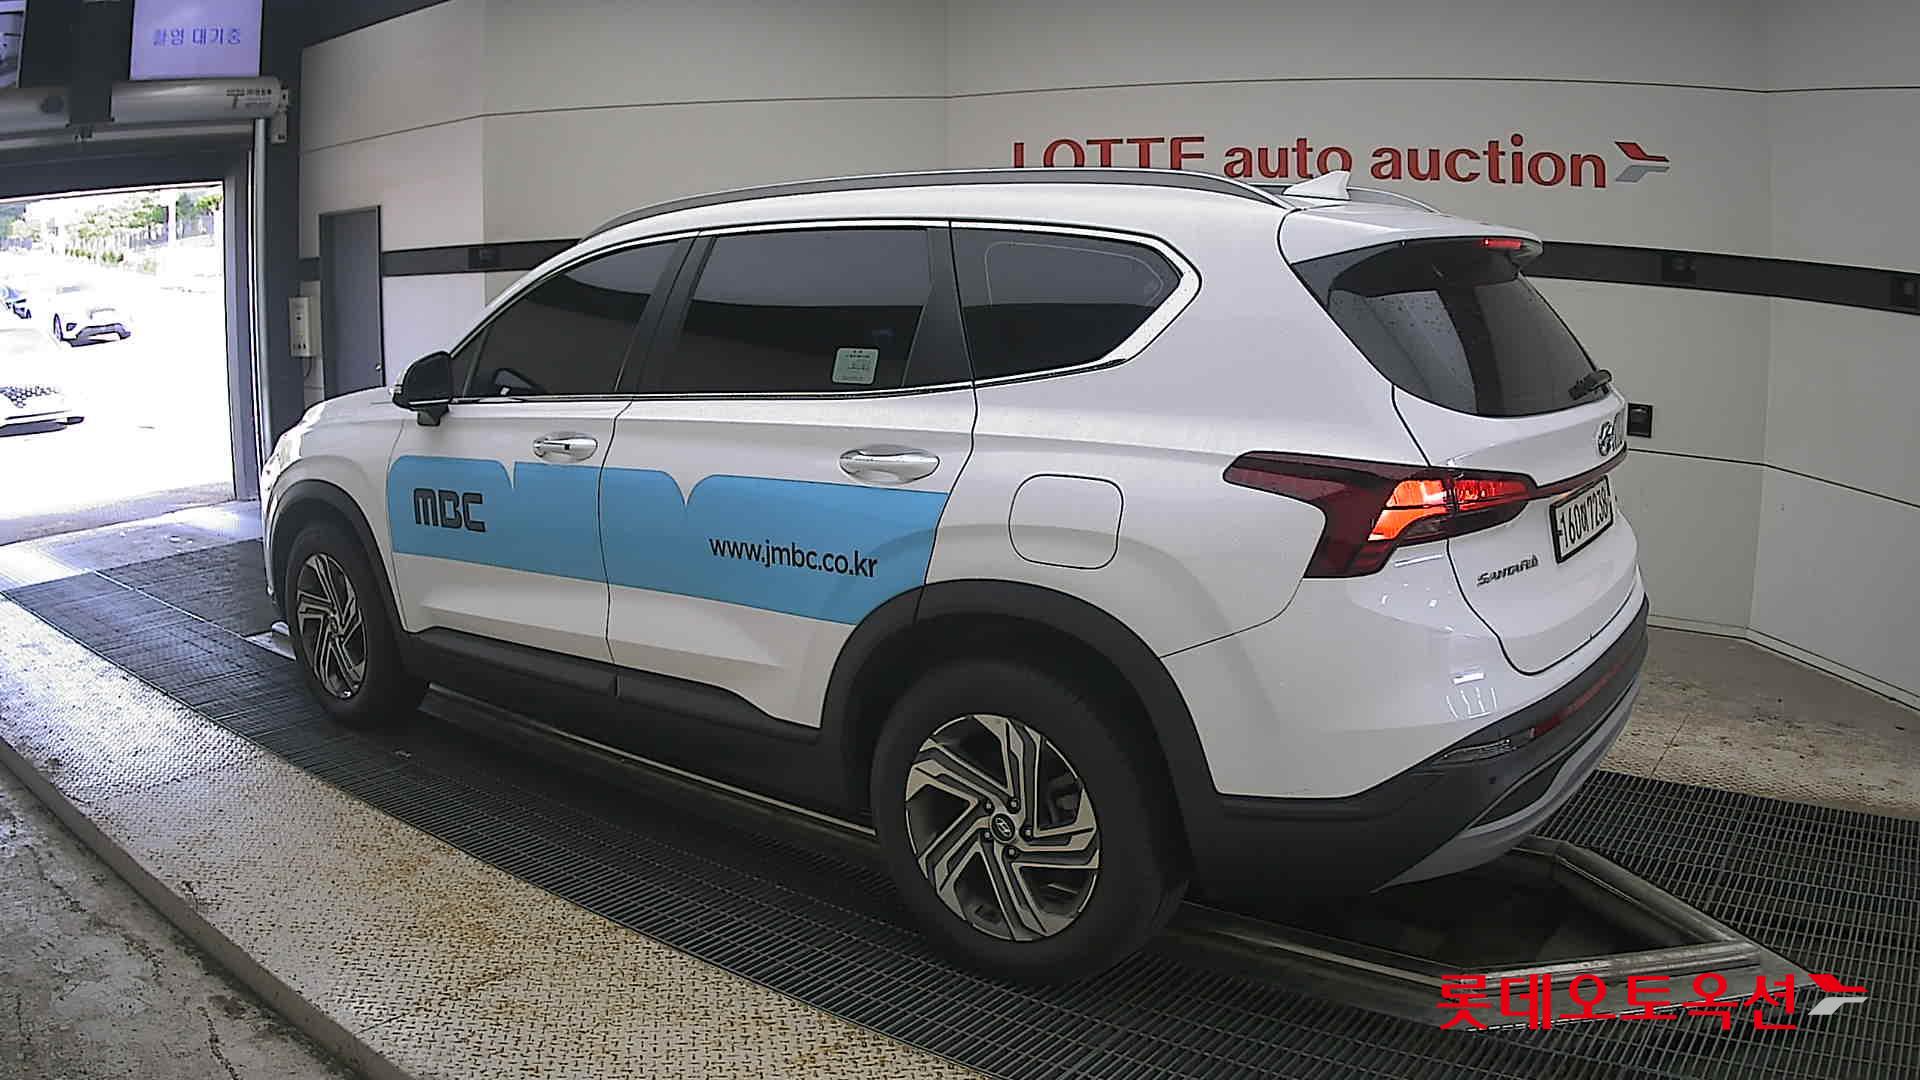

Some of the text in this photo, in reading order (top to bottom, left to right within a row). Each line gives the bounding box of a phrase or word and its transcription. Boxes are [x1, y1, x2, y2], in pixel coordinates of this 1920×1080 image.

[1223, 137, 1353, 179] auto
[1370, 133, 1607, 188] auction
[414, 487, 486, 533] MBC
[709, 539, 878, 578] www.jmbc.co.kr
